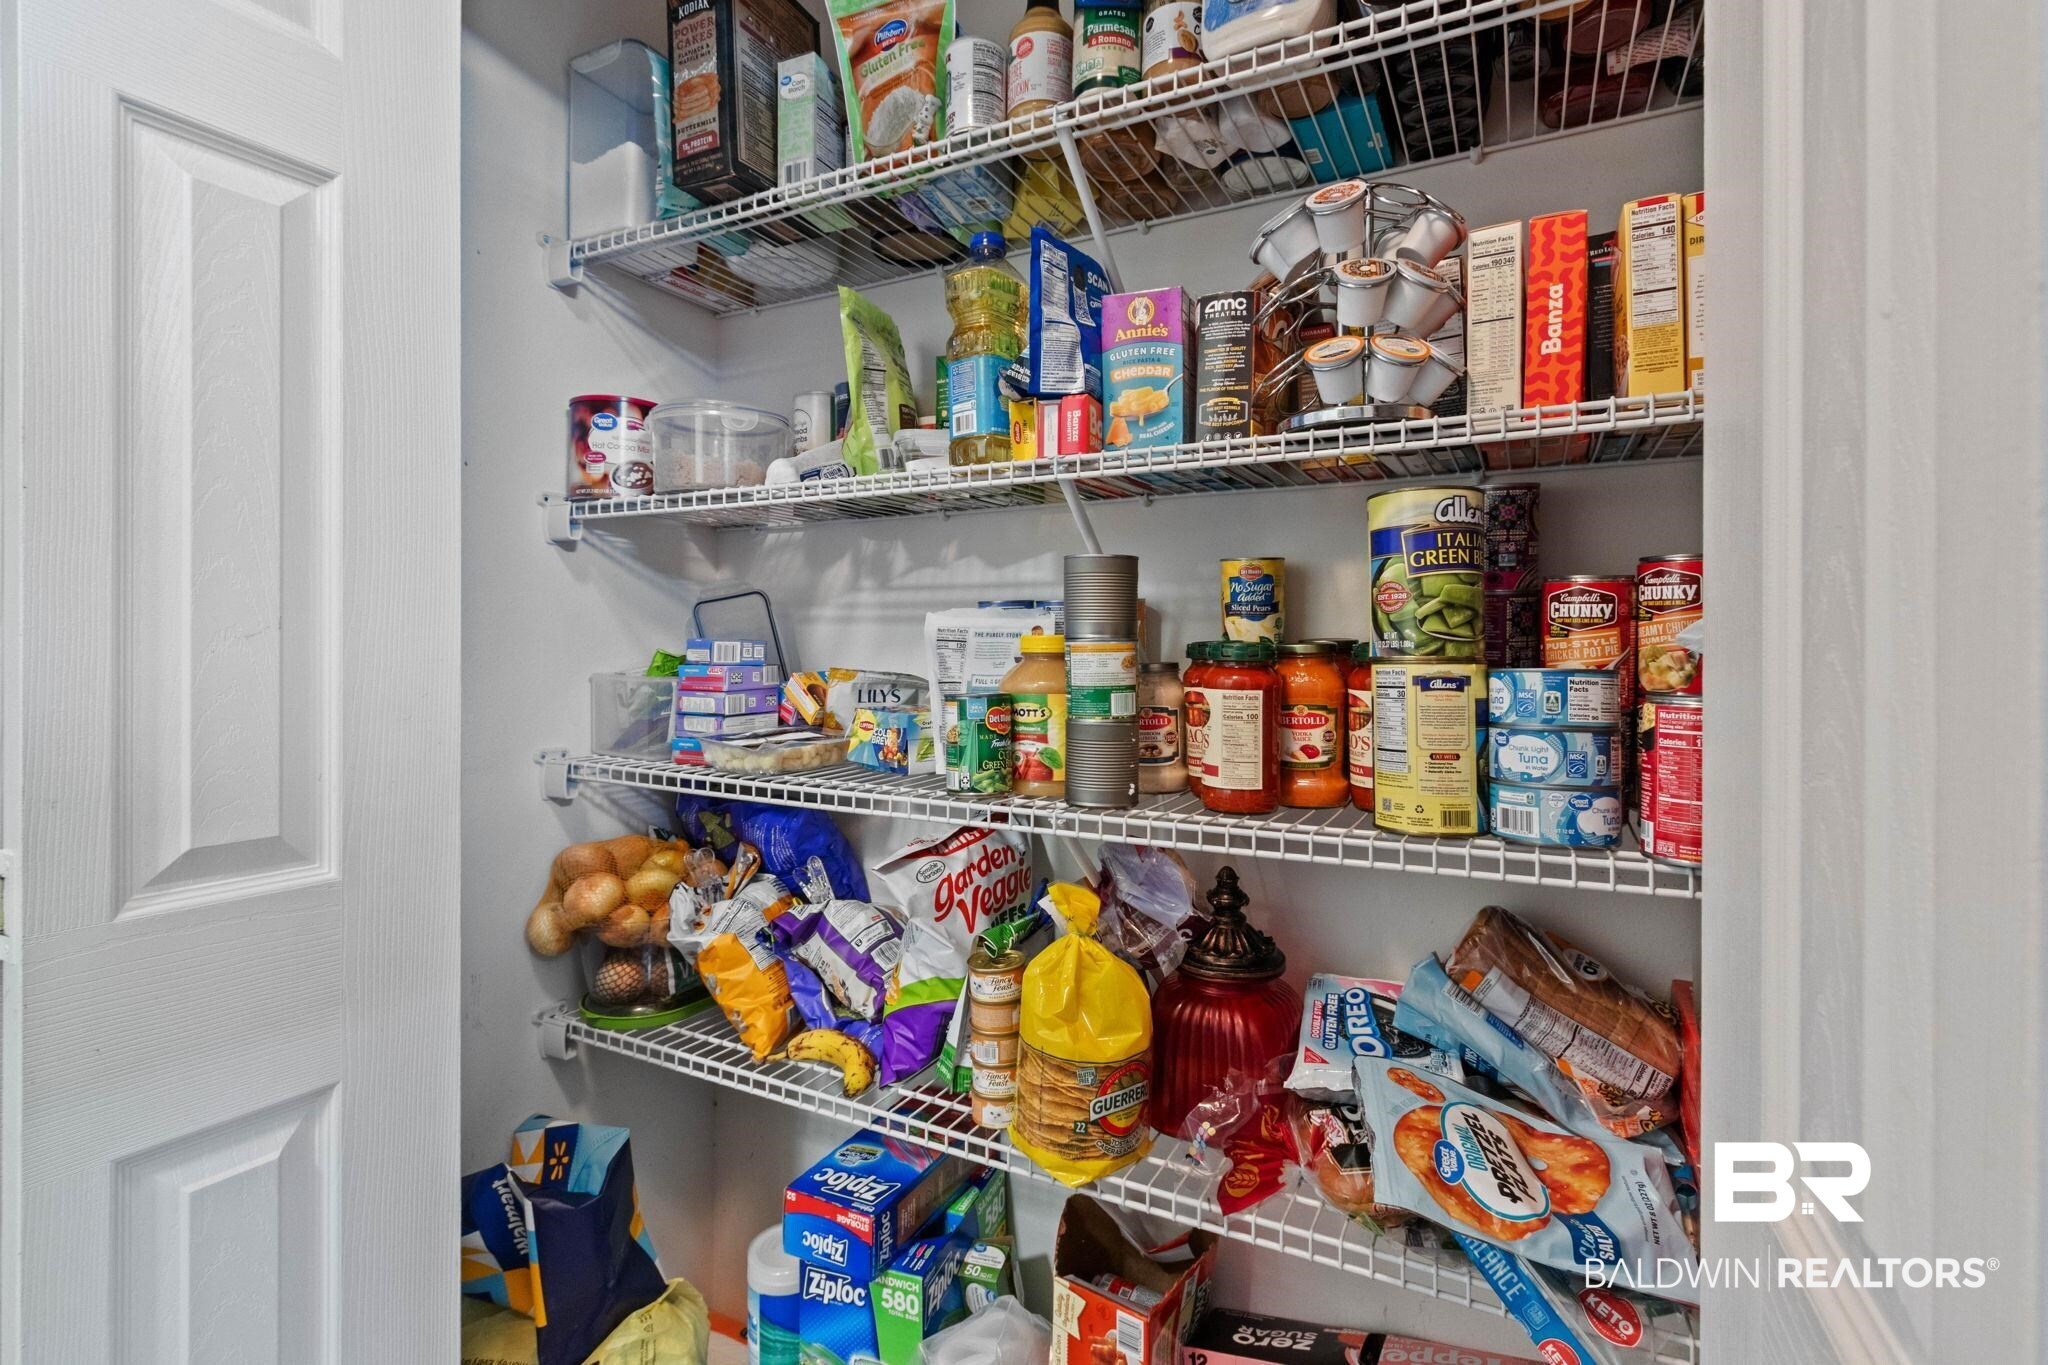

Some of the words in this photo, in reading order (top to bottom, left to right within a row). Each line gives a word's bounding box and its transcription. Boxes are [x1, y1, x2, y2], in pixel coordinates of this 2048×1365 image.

[678, 0, 709, 19] KODIAK
[675, 16, 714, 39] POWER
[1087, 23, 1136, 38] Parmesan
[677, 28, 713, 50] CAKES
[1098, 36, 1131, 47] Romano
[860, 50, 896, 77] Gluten
[898, 39, 925, 56] Free
[677, 117, 716, 135] BUTTERMILK
[1632, 207, 1656, 216] Nutrition
[1658, 203, 1675, 211] Facts
[1632, 231, 1655, 240] Calories
[1662, 225, 1675, 234] 140
[1472, 239, 1497, 247] Nutrition
[1498, 235, 1514, 243] Facts
[1472, 262, 1490, 271] Calories
[1491, 258, 1502, 266] 190
[1503, 256, 1515, 265] 340
[1205, 310, 1247, 320] THEATRES
[1541, 283, 1564, 356] Banza
[1114, 323, 1169, 342] Annie's
[1110, 347, 1147, 361] GLUTEN
[1150, 347, 1176, 357] FREE
[1072, 409, 1081, 442] Banza
[1139, 431, 1153, 439] REAL
[592, 441, 605, 449] Hot
[607, 442, 636, 451] Cocoa
[637, 445, 650, 453] Mix
[1410, 550, 1470, 567] GREEN
[1645, 574, 1681, 585] Campbell's
[1230, 583, 1243, 593] No
[1243, 581, 1274, 596] Sugar
[1639, 585, 1698, 601] CHUNKY
[1237, 592, 1265, 602] Added
[1560, 592, 1600, 604] Campbell's
[1252, 604, 1271, 612] Pears
[1551, 602, 1613, 619] CHUNKY
[1546, 637, 1617, 650] PUB-STYLE
[1546, 649, 1580, 660] CHICKEN
[1584, 647, 1602, 659] POT
[1605, 644, 1619, 656] PIE
[1569, 679, 1599, 687] Nutrition
[989, 714, 998, 723] Del
[1280, 714, 1326, 726] BERTOLLI
[1660, 712, 1703, 721] Nutrition
[874, 728, 891, 736] COLD
[872, 737, 891, 746] BREW
[1530, 745, 1549, 753] Light
[1659, 738, 1687, 746] Calories
[983, 761, 1005, 769] GREEN
[1518, 752, 1549, 764] Tuna
[919, 862, 939, 877] Sensible
[923, 865, 943, 881] Portions
[934, 844, 1016, 922] garden
[956, 866, 1032, 934] Veggie
[991, 903, 1027, 928] UFFS
[990, 974, 1012, 986] Fancy
[992, 982, 1014, 991] Feast
[1314, 1000, 1323, 1015] STUF
[1328, 993, 1339, 1020] FREE
[1312, 1016, 1321, 1038] DOUBLE
[1346, 987, 1385, 1057] OREO
[1325, 1021, 1338, 1049] GLUTEN
[984, 1071, 1009, 1084] Fancy
[1636, 1063, 1648, 1081] Calories
[986, 1078, 1010, 1087] Feast
[1076, 1122, 1086, 1133] 22
[1452, 1123, 1488, 1171] ORIGINAL
[1440, 1146, 1451, 1177] Great
[1450, 1149, 1458, 1172] Value
[1461, 1111, 1523, 1204] PRETZEL
[1487, 1129, 1538, 1203] FLATS
[813, 1167, 890, 1201] Ziploc
[787, 1191, 796, 1201] 52
[837, 1214, 870, 1232] STORAGE
[848, 1212, 870, 1223] GALLON
[1651, 1217, 1660, 1231] WT
[880, 1211, 893, 1265] Ziploc
[1653, 1231, 1661, 1245] NET
[802, 1231, 845, 1263] Ziploc
[964, 1264, 981, 1277] 50
[808, 1271, 866, 1307] Ziploc
[928, 1251, 960, 1316] Ziploc
[881, 1288, 919, 1315] 580
[888, 1309, 904, 1318] TOTAL
[905, 1313, 920, 1322] BAGS
[1586, 1292, 1634, 1336] KETO
[1238, 1324, 1318, 1340] SUGAR
[1232, 1332, 1314, 1351] zero
